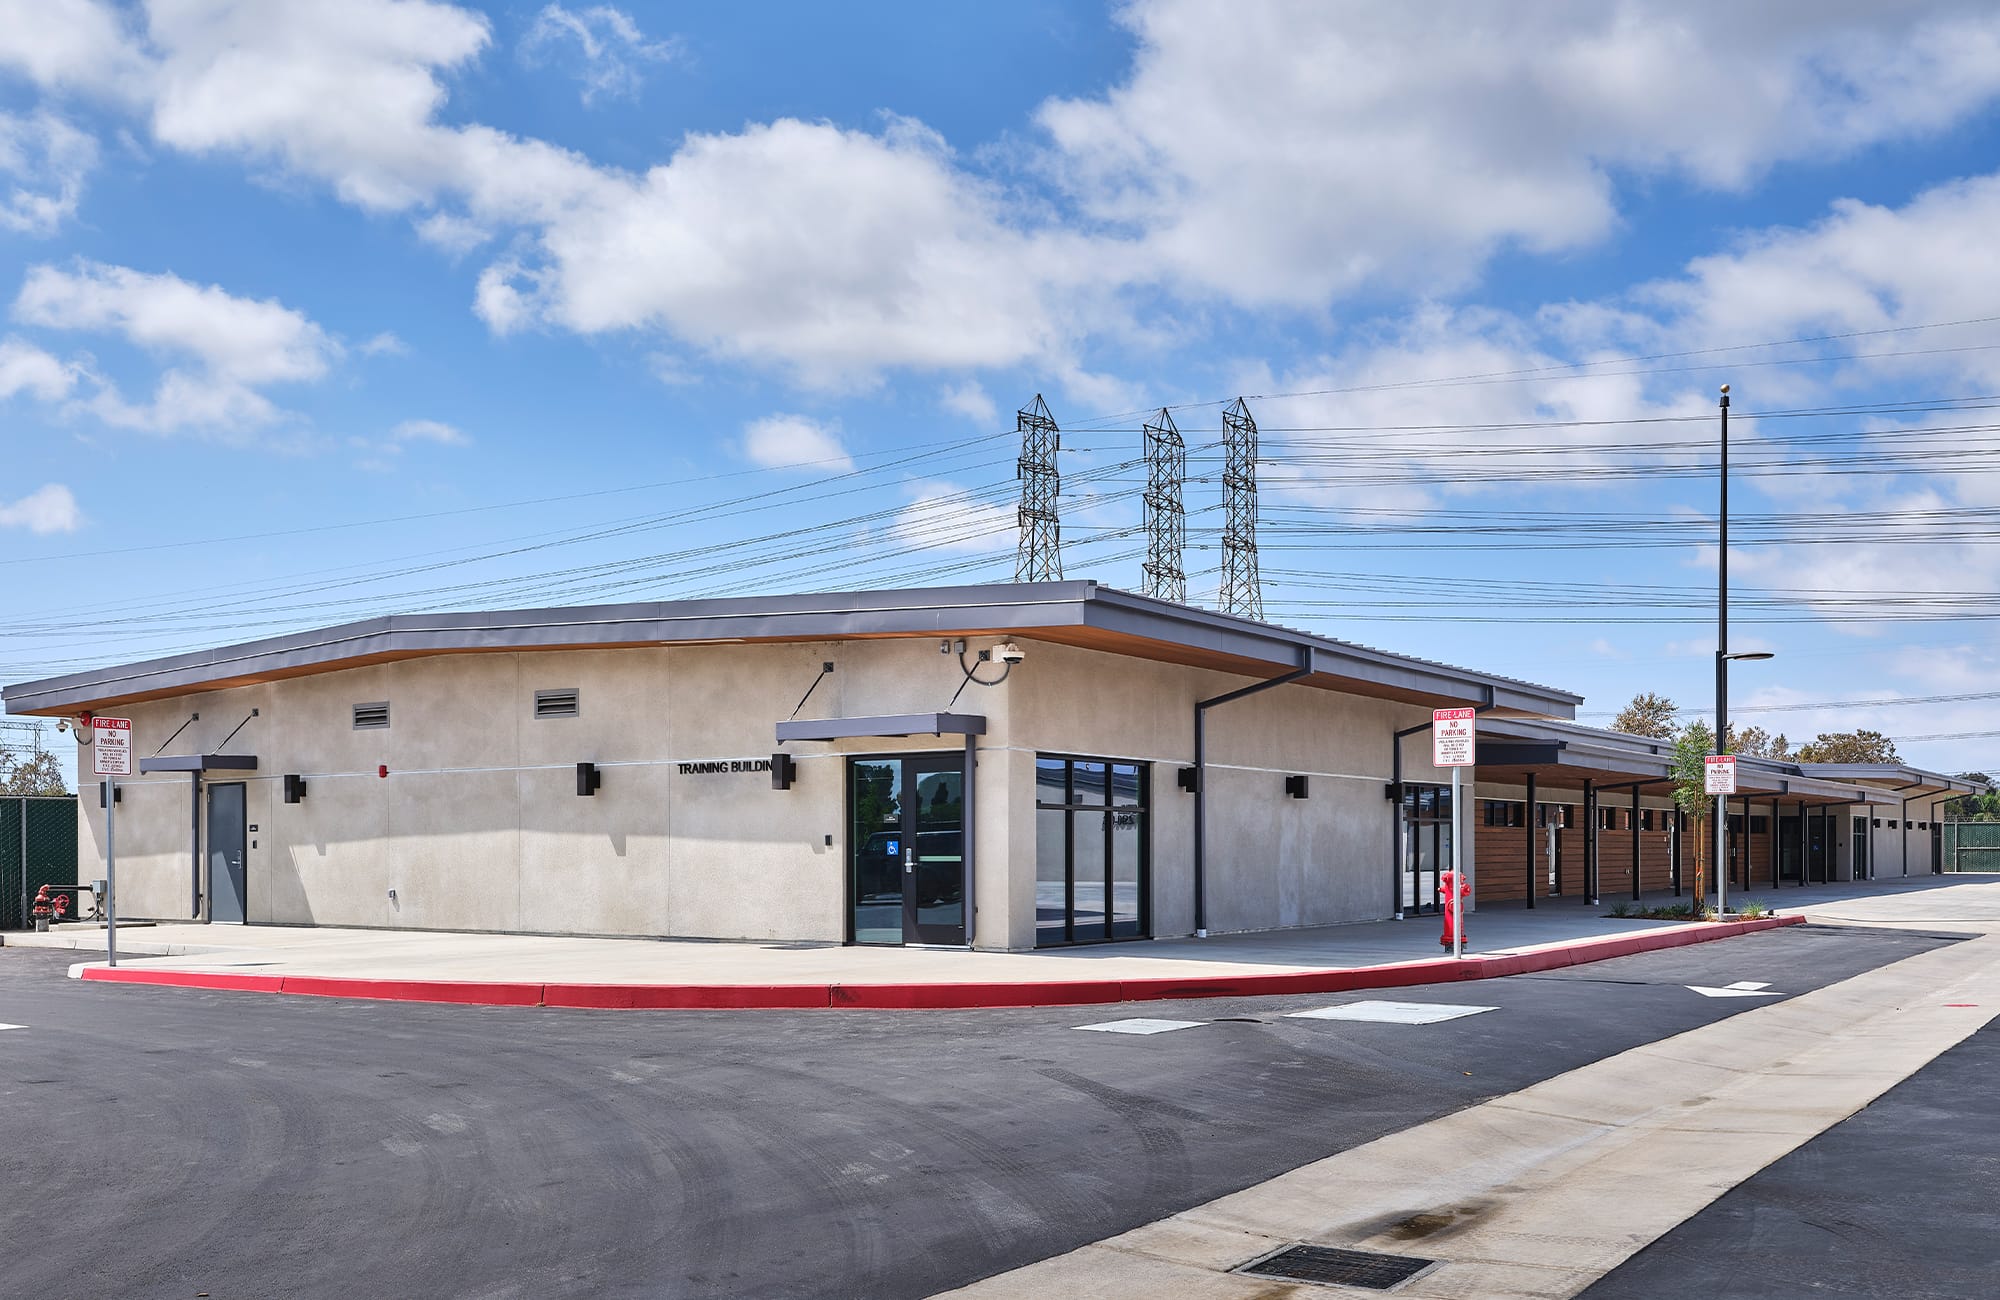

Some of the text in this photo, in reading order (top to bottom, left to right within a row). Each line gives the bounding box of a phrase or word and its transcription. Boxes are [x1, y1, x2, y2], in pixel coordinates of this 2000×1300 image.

[1436, 710, 1471, 719] FIRE LANE
[95, 719, 129, 729] FIRE LANE
[108, 730, 117, 738] NO
[1441, 729, 1467, 737] PARKING
[100, 738, 125, 746] PARKING
[678, 760, 773, 775] TRAINING BUILDIN
